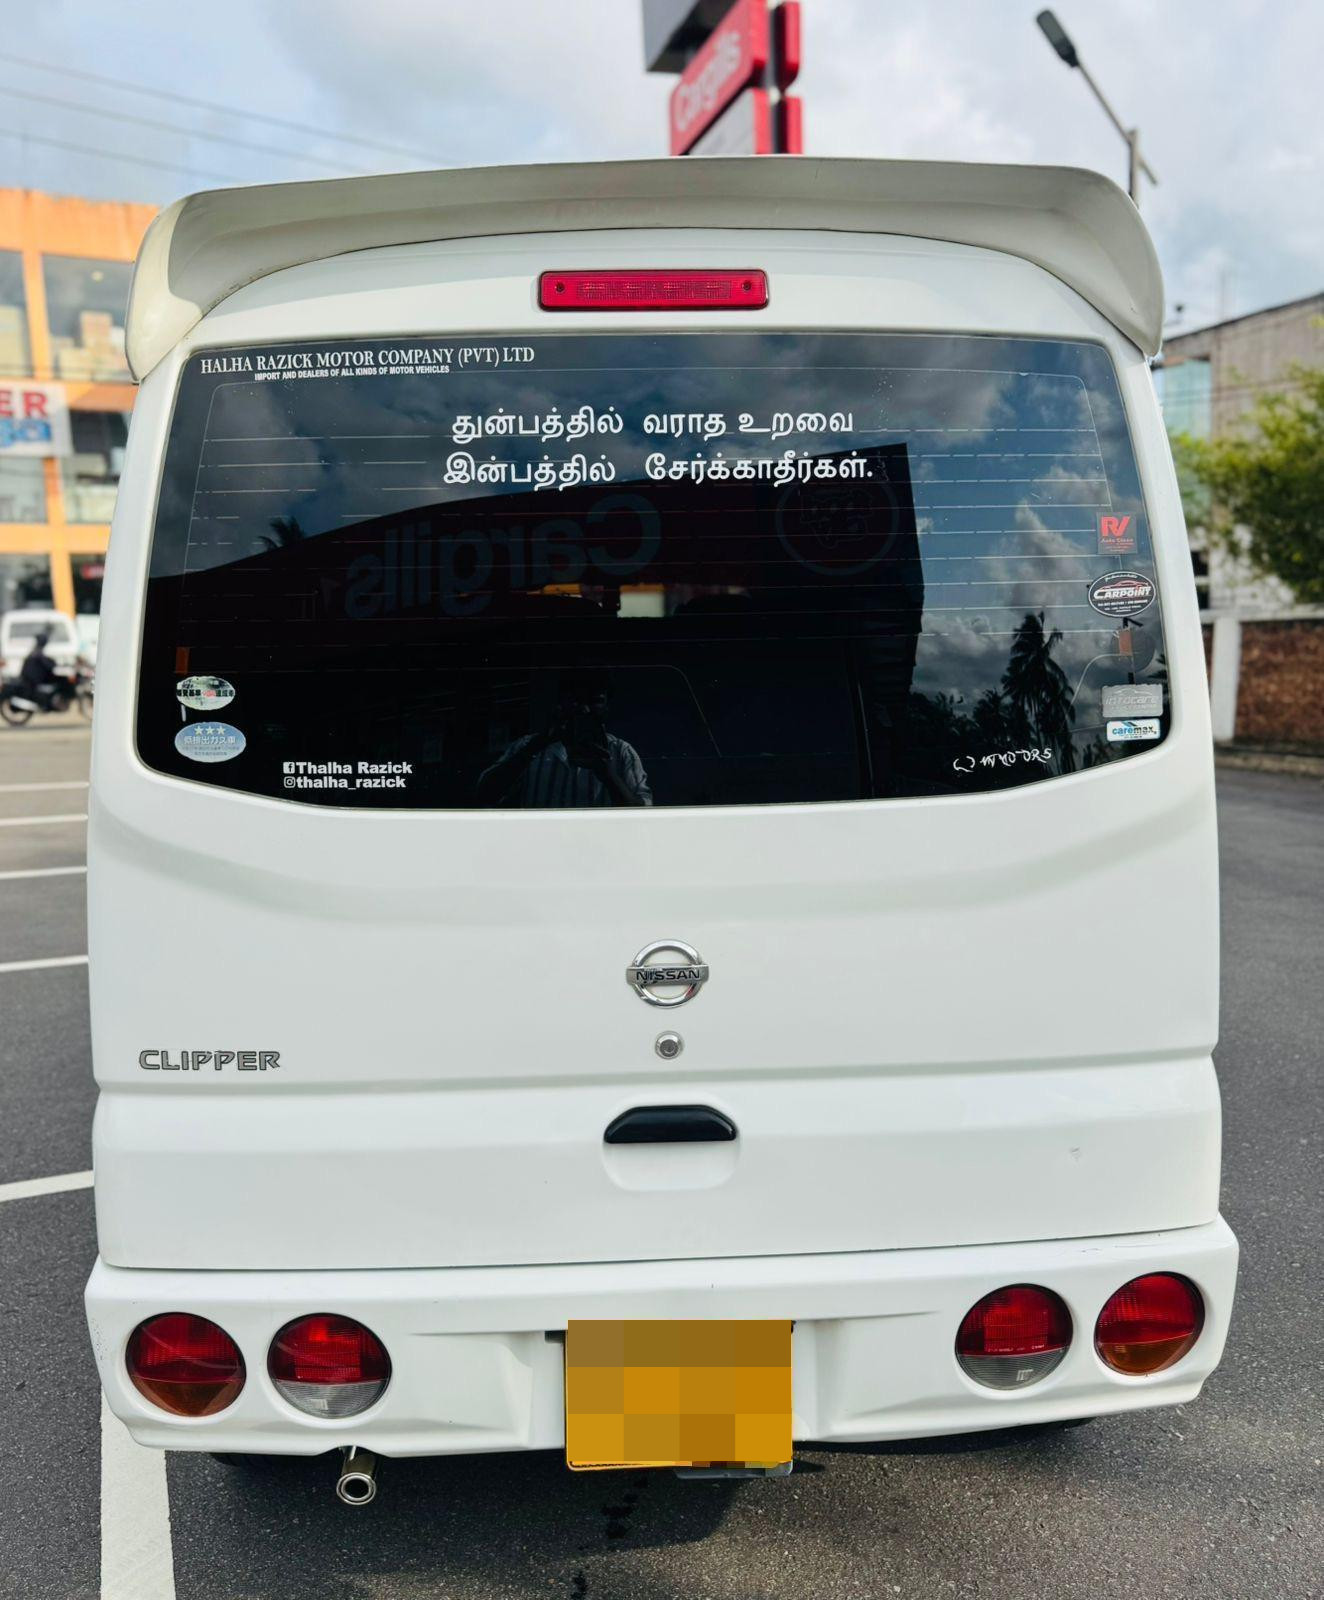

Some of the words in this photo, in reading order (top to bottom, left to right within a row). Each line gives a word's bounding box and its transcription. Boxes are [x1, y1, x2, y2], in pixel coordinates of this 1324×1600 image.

[201, 357, 253, 374] HALHA
[256, 353, 313, 371] RAZICK
[316, 351, 375, 368] MOTOR
[378, 348, 454, 366] COMPANY
[458, 346, 500, 368] (PVT)
[503, 347, 535, 363] LTD
[254, 372, 281, 381] IMPORT
[282, 371, 297, 380] AND
[298, 369, 329, 379] DEALERS
[330, 369, 340, 377] OF
[341, 368, 354, 376] ALL
[355, 366, 378, 376] KINDS
[378, 366, 389, 375] OF
[389, 365, 415, 375] MOTOR
[415, 365, 450, 374] VEHICLES
[451, 405, 624, 445] துன்பத்தில்
[643, 412, 727, 442] வராத
[738, 412, 854, 441] உறவை
[443, 451, 616, 492] இன்பத்தில்
[645, 450, 873, 488] சேர்க்காதீர்கள்.
[1093, 586, 1152, 599] CARPOINT
[296, 761, 353, 774] Thalha
[357, 761, 412, 774] Razick
[296, 776, 406, 790] thalha_razick
[636, 969, 700, 981] NISSAN
[138, 1050, 281, 1071] CLIPPER
